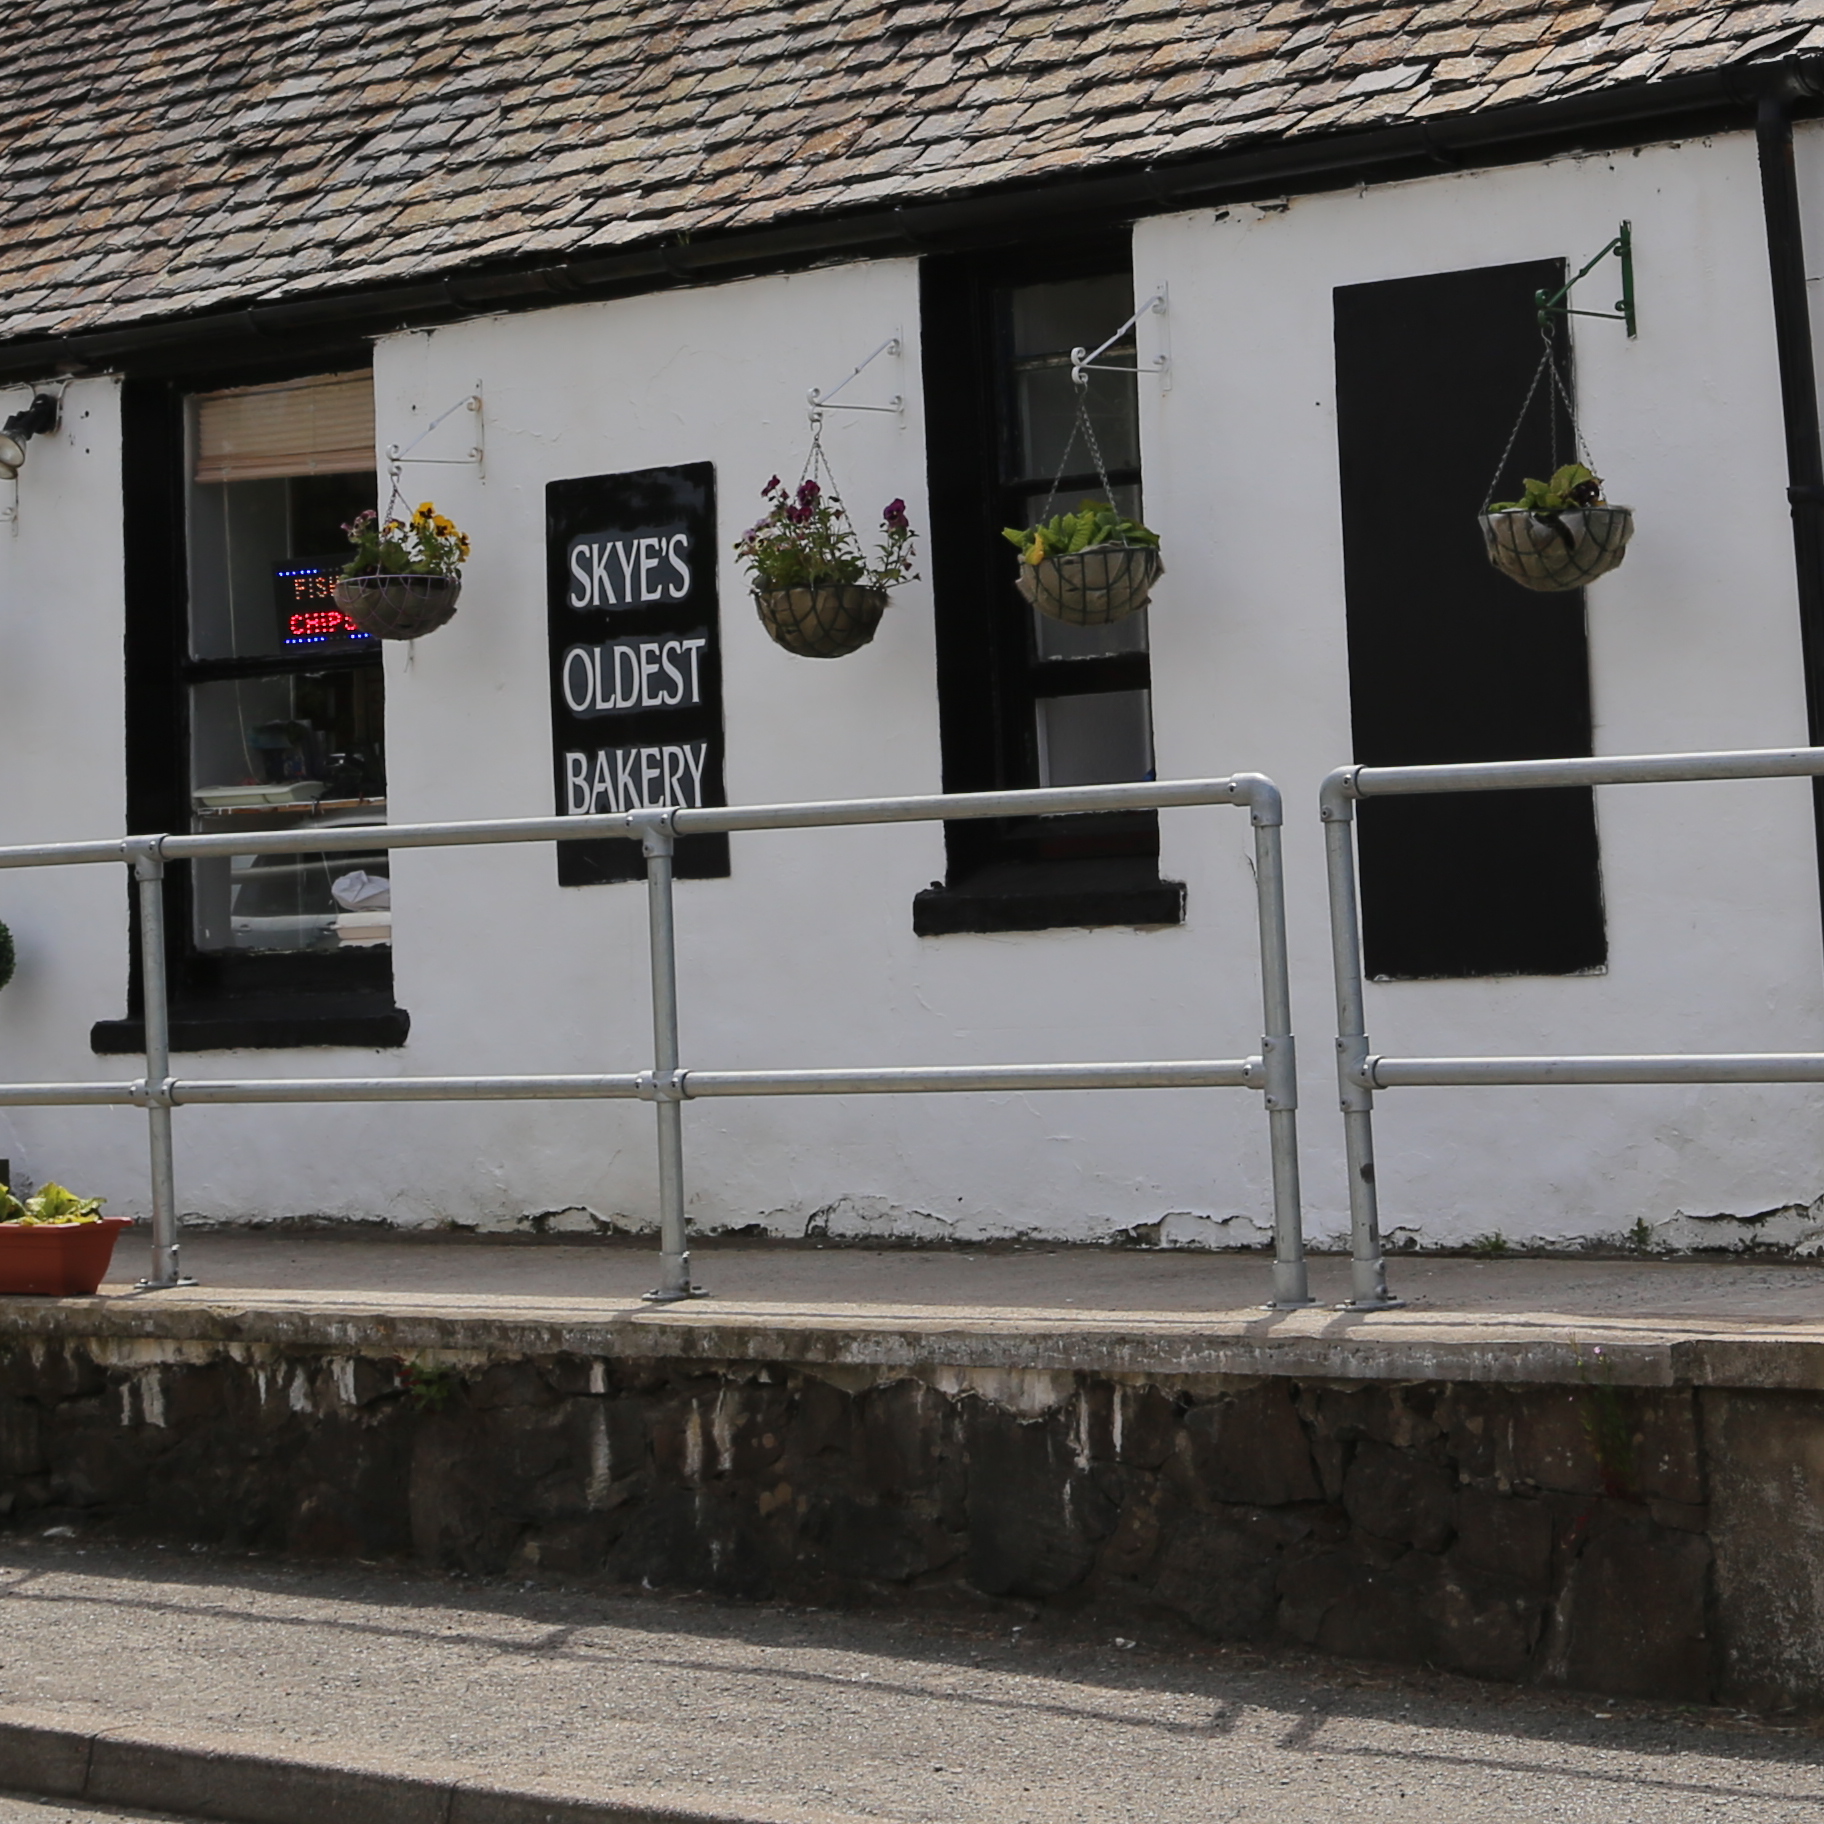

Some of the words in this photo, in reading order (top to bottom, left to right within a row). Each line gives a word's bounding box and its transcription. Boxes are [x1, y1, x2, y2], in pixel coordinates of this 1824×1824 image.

[570, 533, 691, 608] SKYE'S
[563, 638, 706, 712] OLDEST
[565, 743, 707, 815] BAKERY
